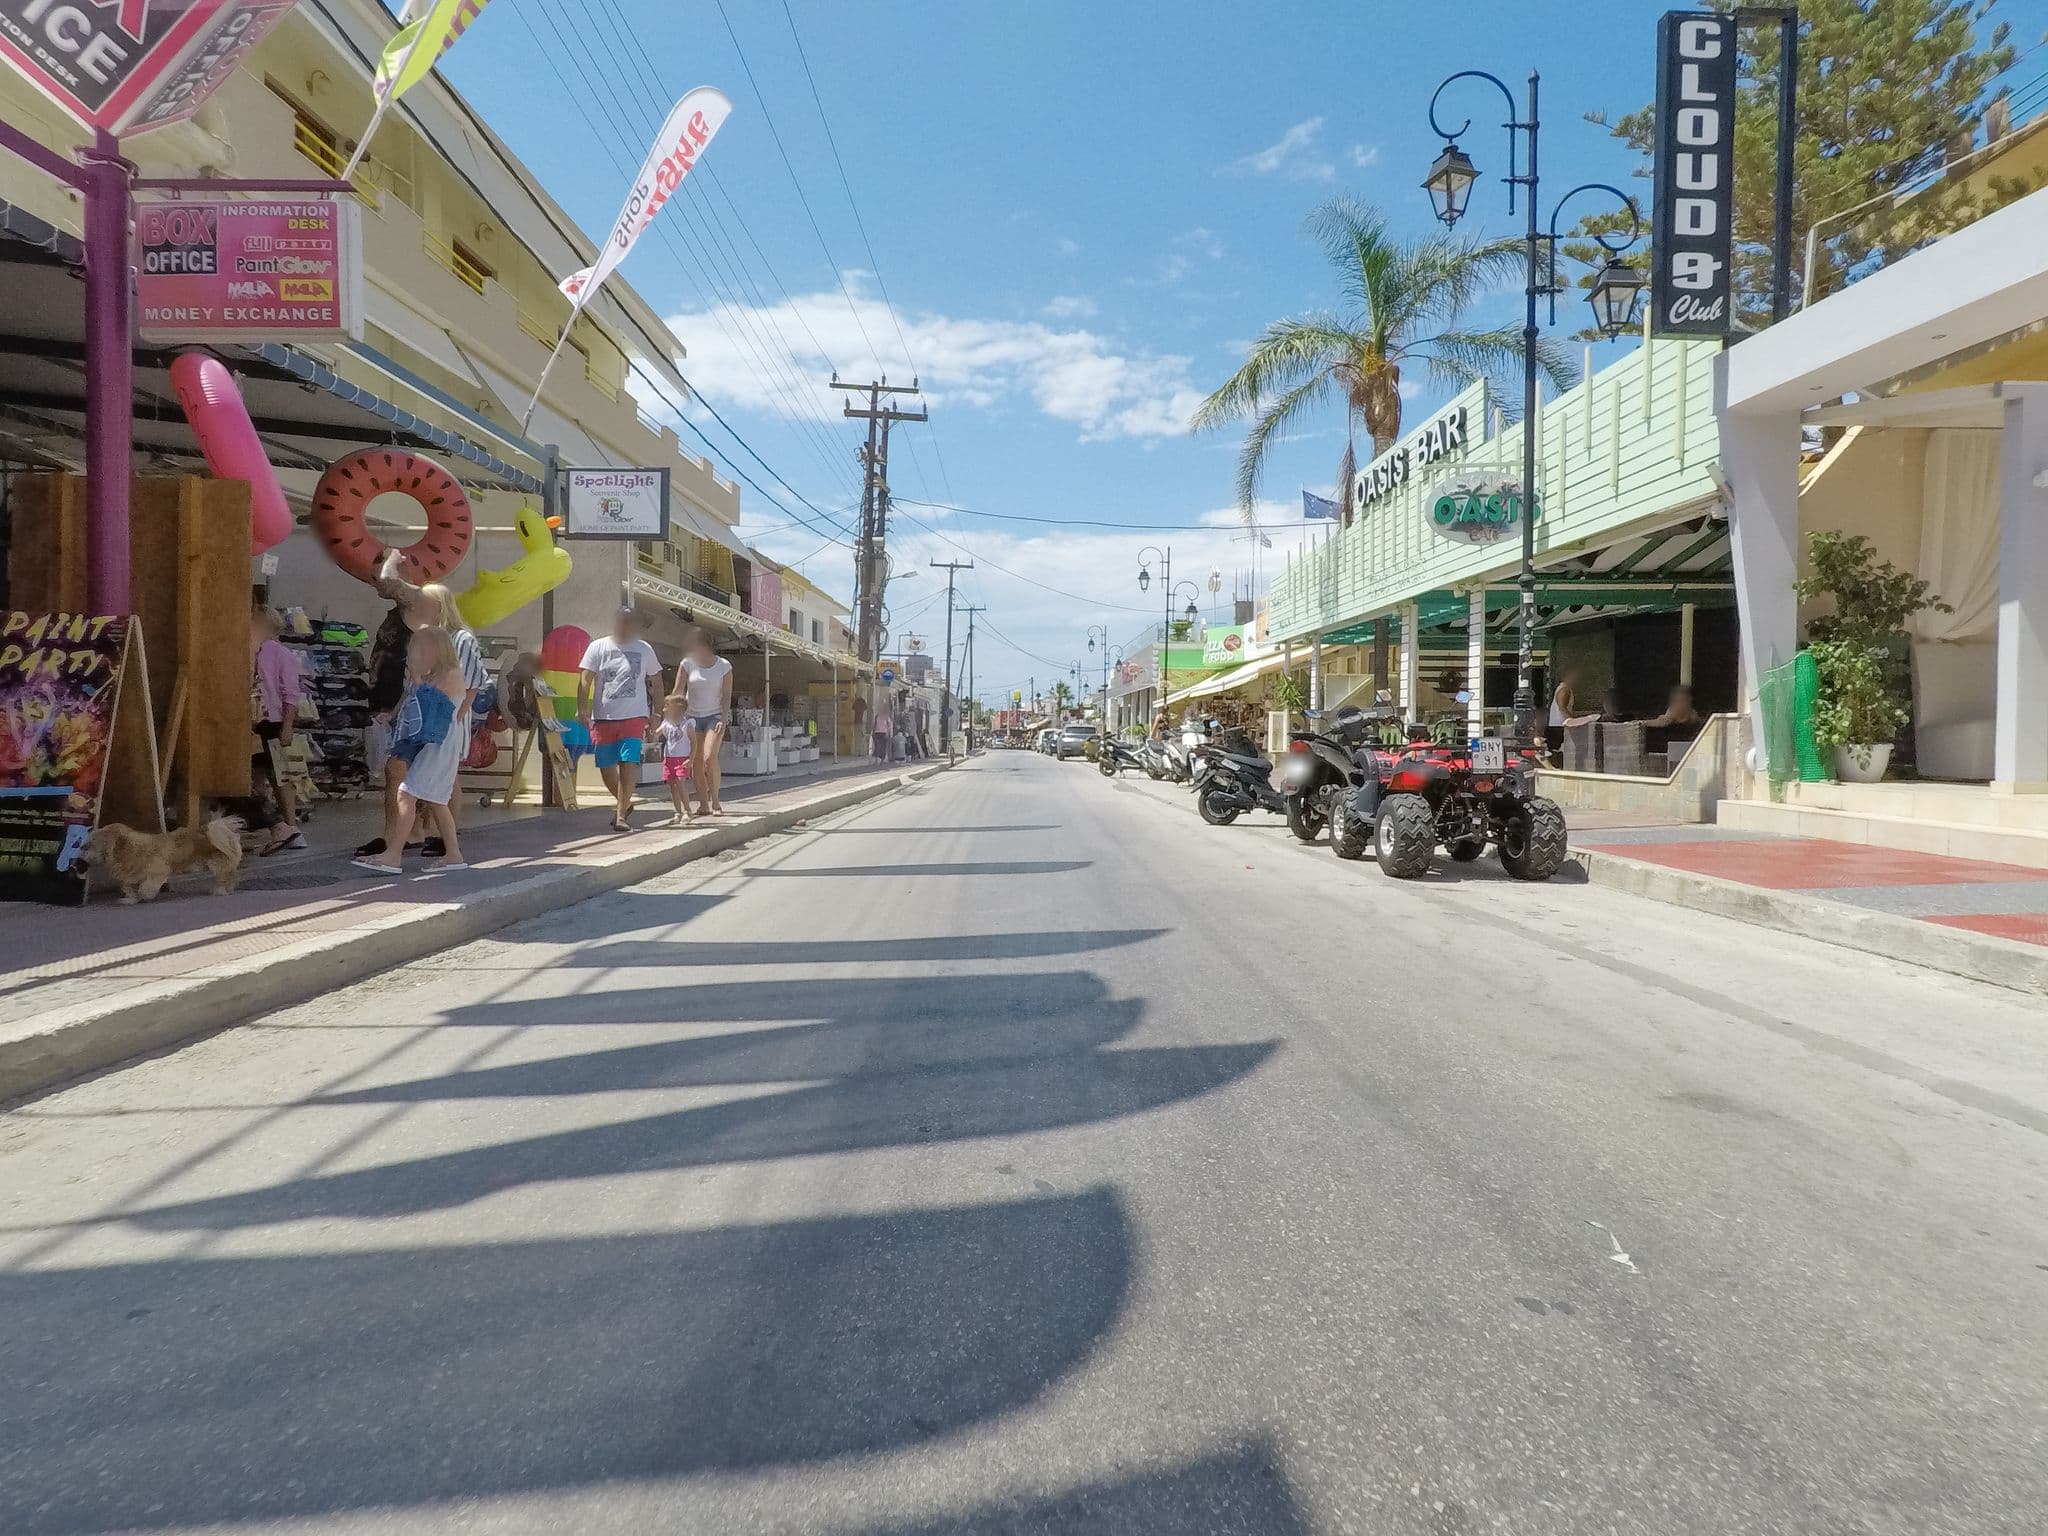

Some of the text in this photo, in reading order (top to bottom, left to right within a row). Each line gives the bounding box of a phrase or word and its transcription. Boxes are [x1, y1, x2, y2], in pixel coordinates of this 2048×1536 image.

[35, 46, 80, 88] DESK
[1674, 20, 1721, 236] CLOUD
[223, 205, 330, 217] INFORMATION
[143, 209, 215, 246] BOX
[288, 219, 330, 230] DESK
[145, 251, 215, 273] OFFICE
[145, 307, 332, 320] MONEY EXCHANGE
[1669, 294, 1724, 324] Club
[1357, 406, 1467, 508] OASIS BAR
[574, 475, 655, 489] Spotlight
[2, 611, 117, 648] PAINT
[0, 644, 104, 682] PARTY
[1480, 741, 1501, 752] BNY
[1484, 755, 1499, 767] 91
